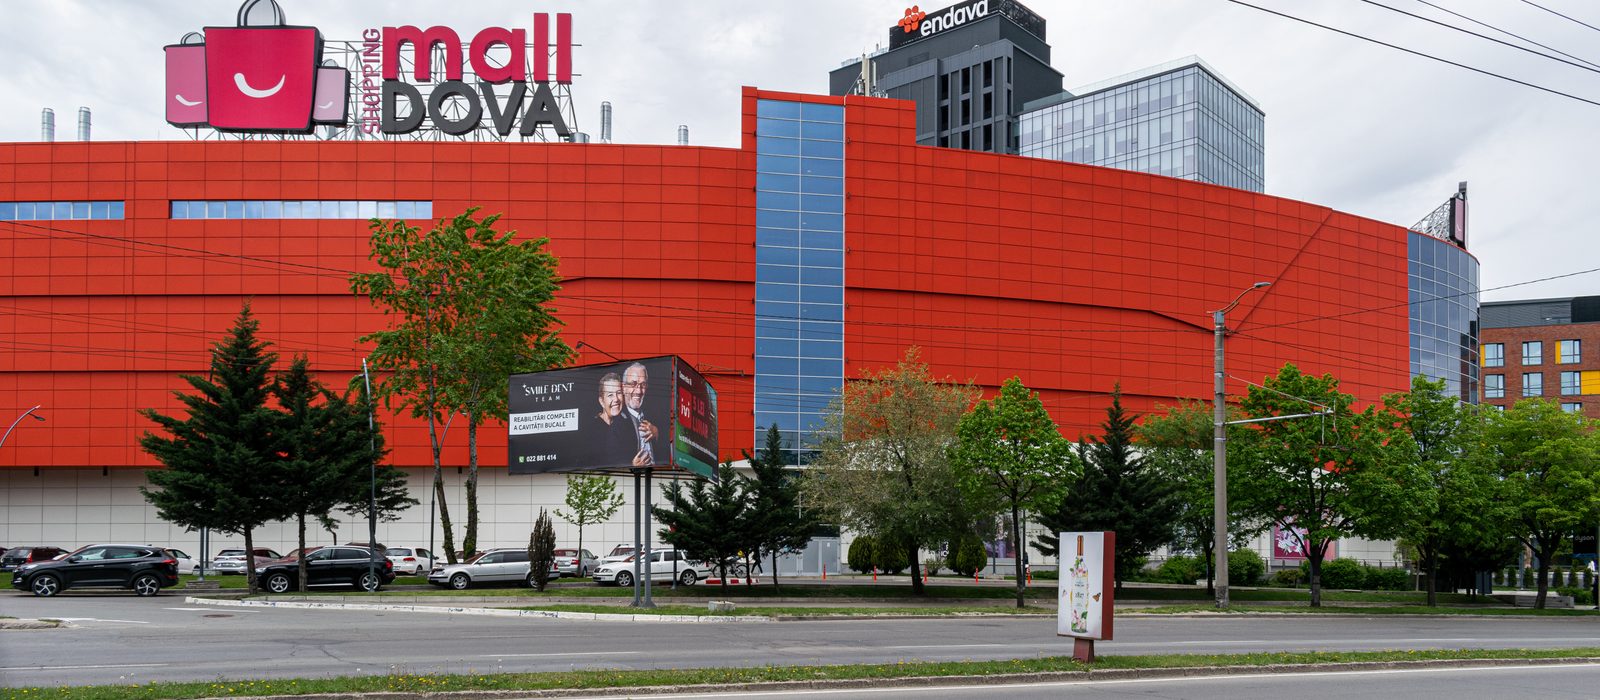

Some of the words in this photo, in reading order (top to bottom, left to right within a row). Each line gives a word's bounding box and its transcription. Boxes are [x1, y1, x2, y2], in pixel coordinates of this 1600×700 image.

[920, 0, 988, 37] endava
[382, 13, 572, 84] mall
[362, 28, 381, 134] SHOPPING
[381, 81, 570, 136] DOVA
[525, 384, 549, 396] SMILE
[551, 382, 574, 393] DENT
[544, 421, 566, 429] BUCALE
[546, 412, 575, 420] COMPLETE
